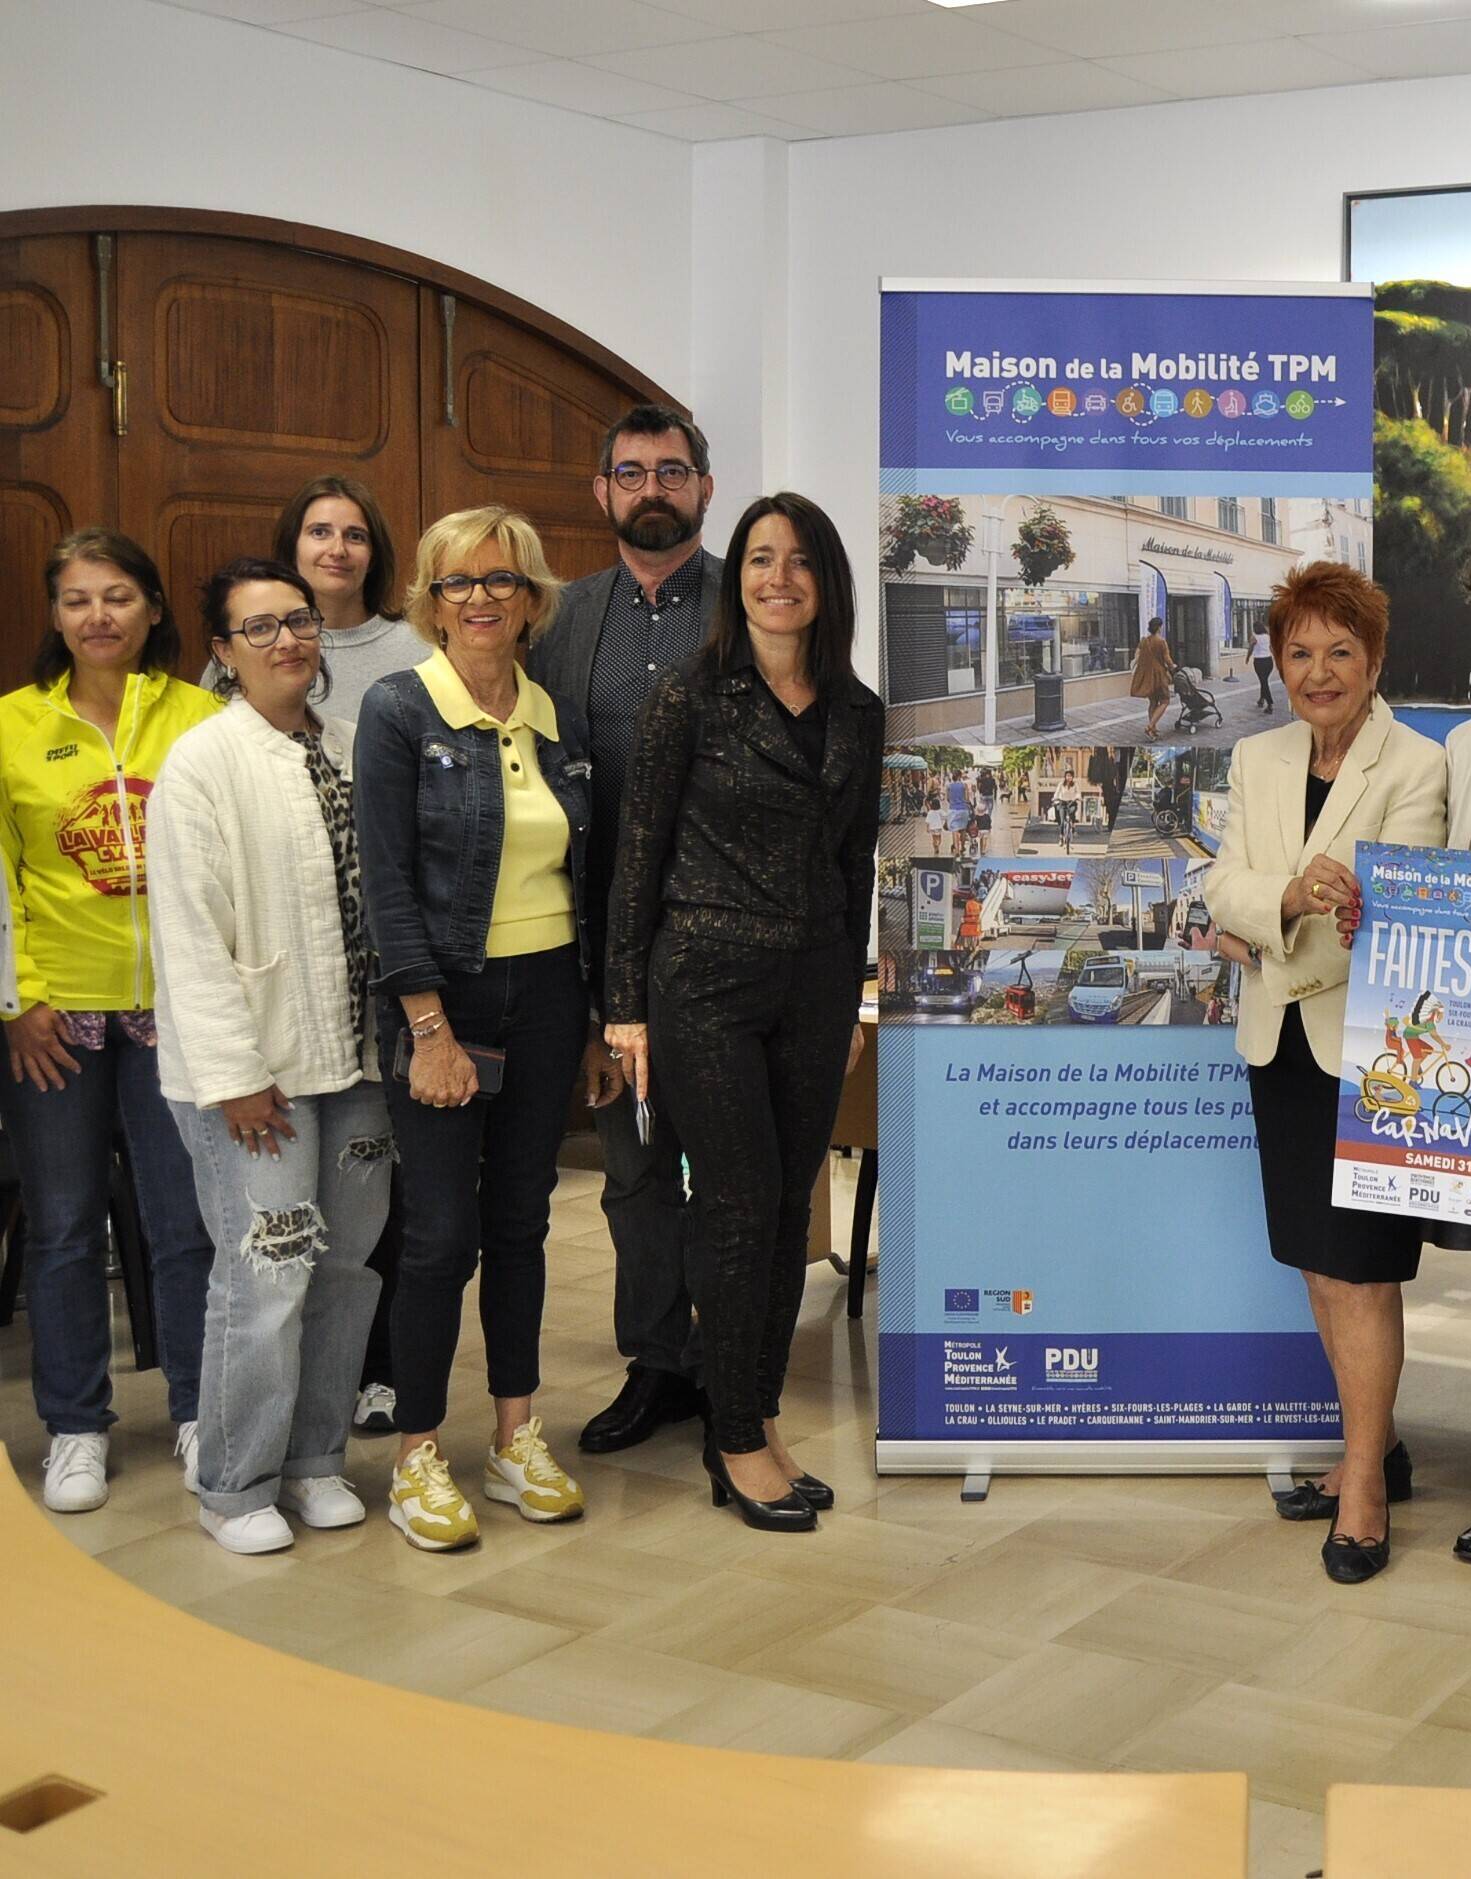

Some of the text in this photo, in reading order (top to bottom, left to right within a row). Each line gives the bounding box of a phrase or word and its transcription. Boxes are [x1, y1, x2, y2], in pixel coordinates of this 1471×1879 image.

[946, 351, 1336, 382] Maison de la Mobilité TPM
[945, 429, 1313, 452] Vous accompagne dans tous vos déplacements
[1013, 873, 1074, 885] easyJet
[1372, 865, 1422, 883] Maison
[1425, 873, 1438, 884] de
[1440, 874, 1451, 886] la
[945, 1062, 1250, 1082] La Maison de la Mobilité TPM
[979, 1098, 1000, 1115] et
[1005, 1100, 1137, 1120] accompagne
[1143, 1098, 1188, 1116] tous
[1194, 1097, 1225, 1116] les
[1007, 1130, 1057, 1150] dans
[1063, 1130, 1118, 1150] leurs
[1405, 1152, 1455, 1170] SAMEDI
[1458, 1159, 1471, 1172] 31
[1409, 1187, 1440, 1204] PDU
[944, 1349, 982, 1360] TOULON
[1045, 1348, 1099, 1370] PDU
[944, 1361, 994, 1373] PROVENCE
[944, 1374, 1018, 1385] MÉDITERRANÉE
[945, 1402, 1340, 1413] TOULON LA SEYNE-SUR-MER HYÈRES SIX-FOURS-LES-PLAGES LA GARDE LA VALETTE-DU-VAR
[945, 1414, 1340, 1425] LA CRAU OLLIOULES LE PRADET CARQUEIRANNE SAINT-MANDRIER-SUR-MER LE REVEST-LES-EAUX
